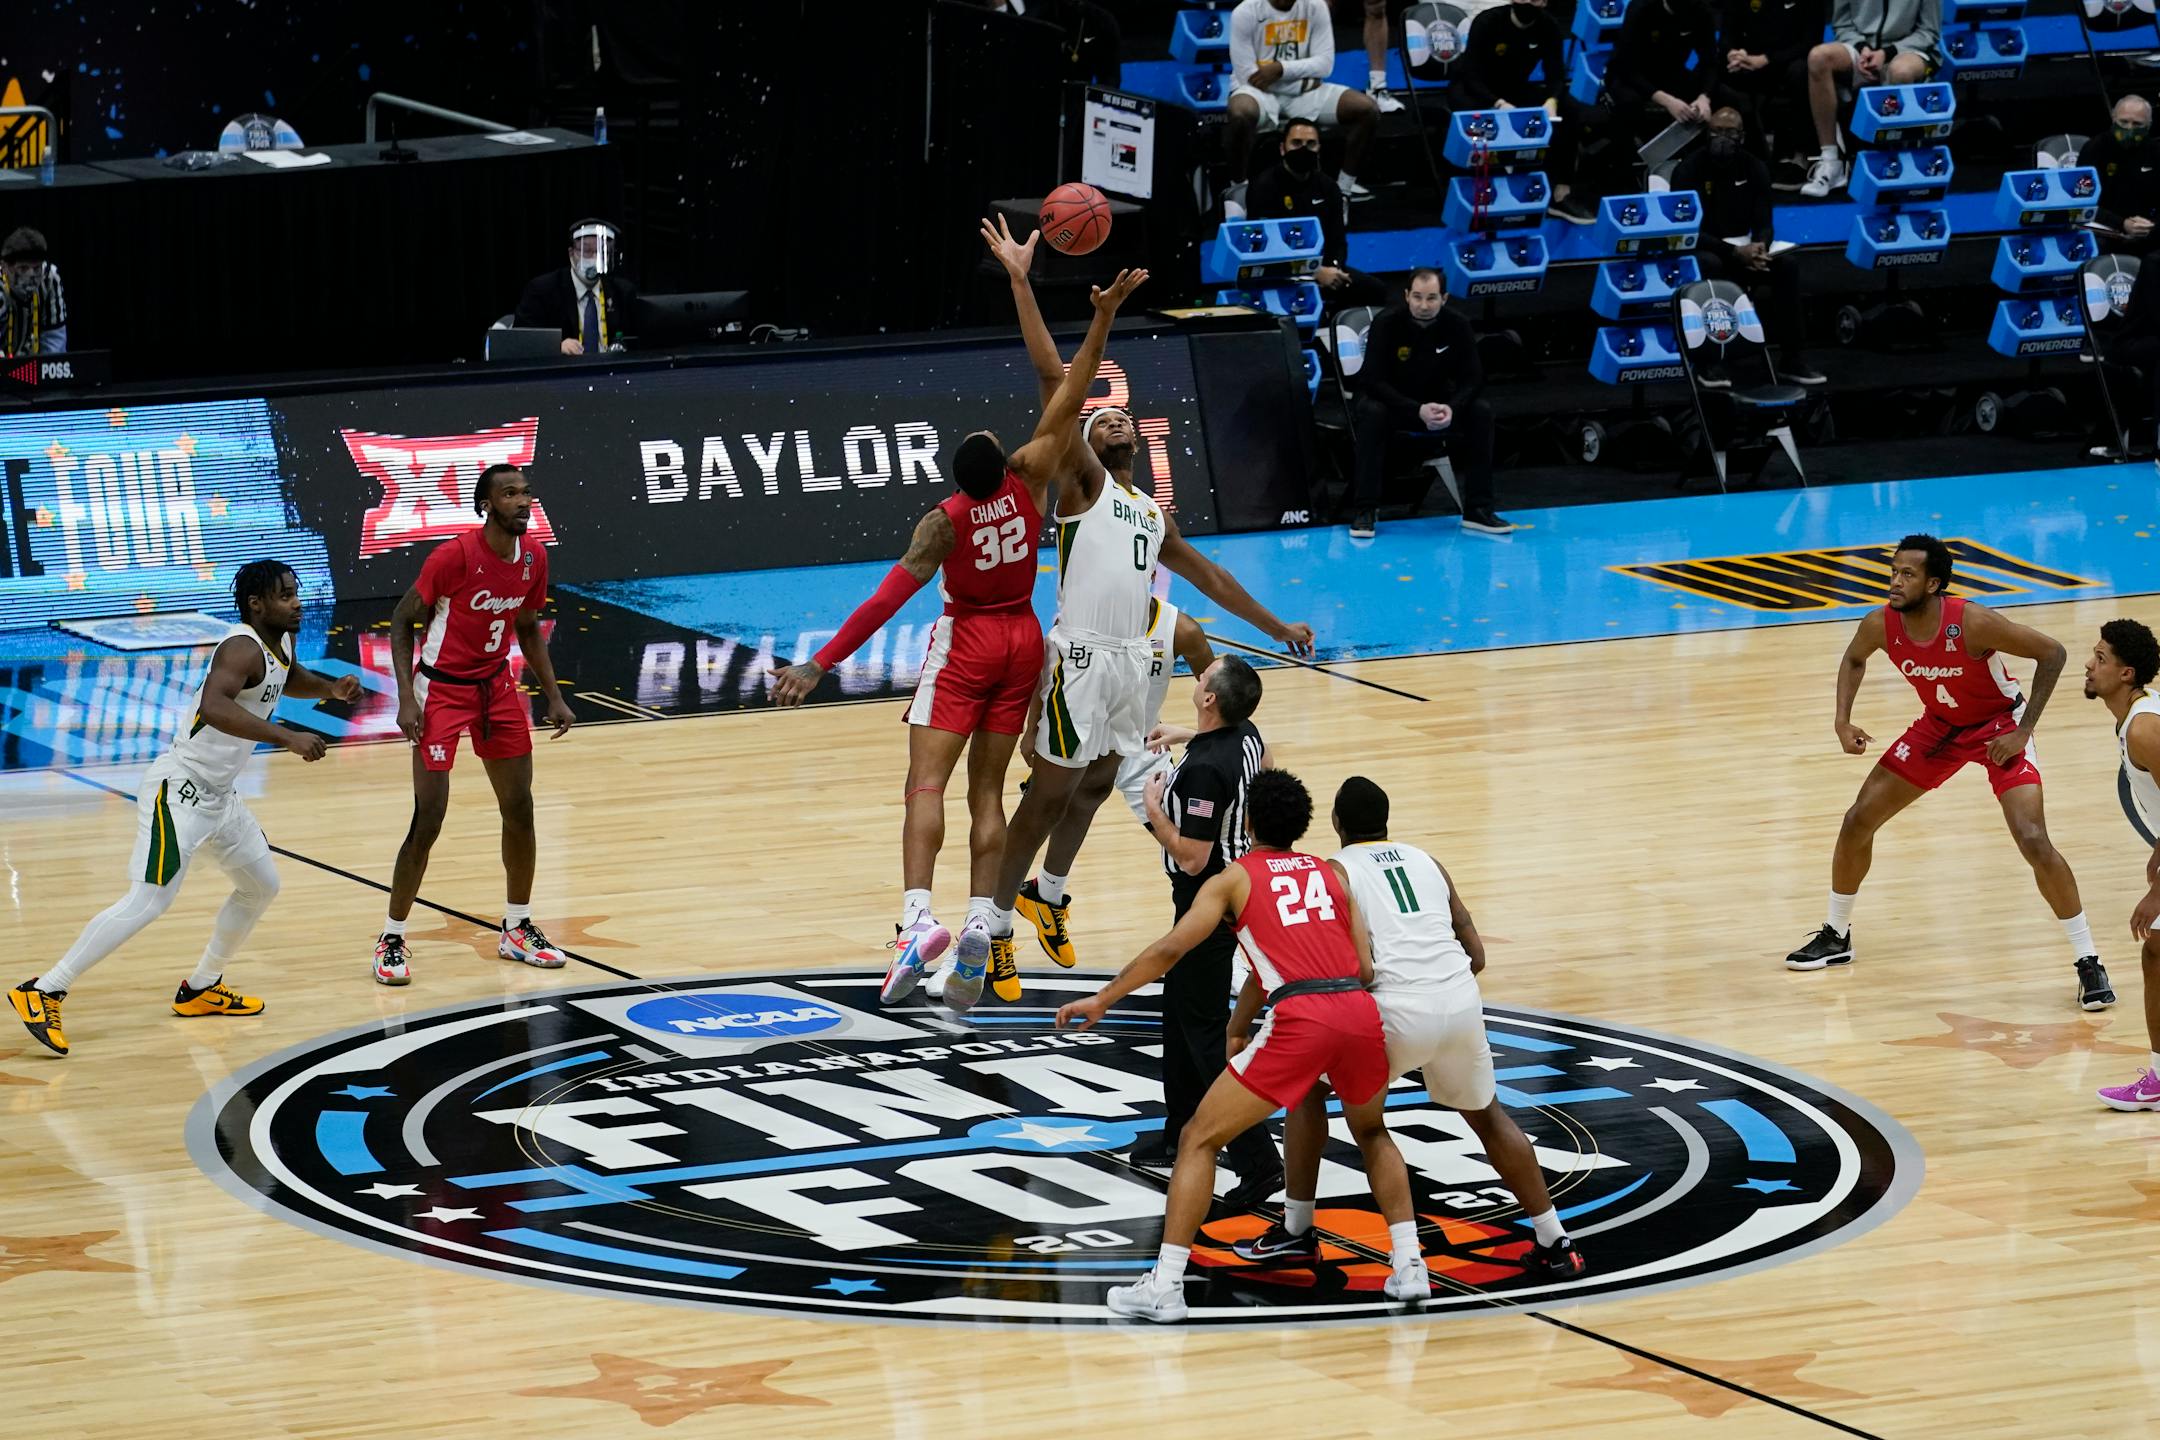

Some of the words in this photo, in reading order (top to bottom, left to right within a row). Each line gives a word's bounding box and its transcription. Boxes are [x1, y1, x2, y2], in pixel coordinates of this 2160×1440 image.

[1957, 69, 2016, 81] POWERADE
[1877, 252, 1940, 268] POWERADE
[1471, 280, 1537, 296] POWERADE
[2020, 338, 2083, 354] POWERADE
[41, 361, 74, 380] POSS.
[640, 422, 944, 503] BAYLOR
[51, 449, 207, 574] FOUR
[970, 493, 1018, 525] CHANEY
[1280, 510, 1310, 524] ANC
[972, 516, 1029, 571] 32
[1134, 533, 1148, 571] 0
[484, 620, 505, 653] 3
[1901, 660, 1963, 681] Cougars
[1936, 684, 1959, 709] 4
[1266, 856, 1316, 873] GRIMES
[1370, 849, 1405, 863] VITAL
[1270, 870, 1336, 927] 24
[1383, 866, 1420, 913] 11
[667, 1006, 842, 1034] NCAA
[588, 1032, 1116, 1093] INDIANAPOLIS
[473, 1046, 1418, 1170] FINA
[1013, 1229, 1133, 1254] 20
